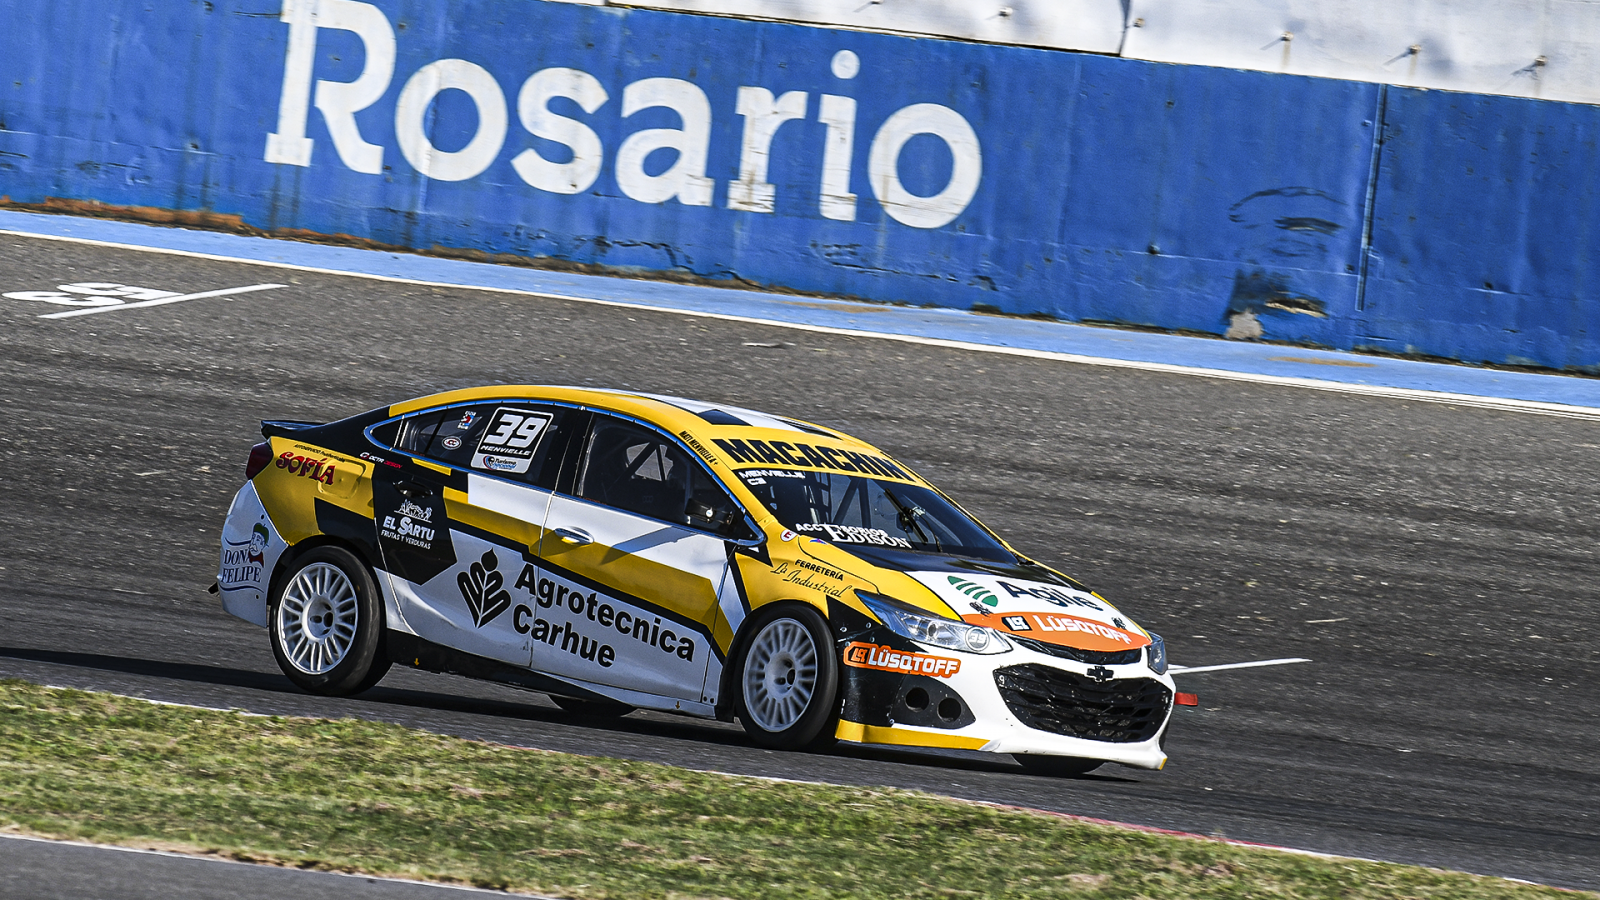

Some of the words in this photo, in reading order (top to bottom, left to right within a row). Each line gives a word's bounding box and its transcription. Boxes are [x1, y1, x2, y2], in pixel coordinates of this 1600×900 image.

[265, 0, 982, 229] Rosario
[484, 413, 547, 448] 39
[480, 445, 532, 456] MENVIELLE
[275, 452, 336, 485] SOFÍA
[738, 470, 805, 479] MENVIELLE
[381, 529, 400, 541] FRUTAS
[405, 536, 431, 550] VERDURAS
[383, 515, 397, 530] EL
[397, 516, 436, 540] SARTU
[224, 549, 249, 565] DON
[221, 566, 262, 583] FELIPE
[770, 562, 788, 574] La
[782, 569, 852, 598] Industrial
[795, 559, 844, 581] FERRETERÍA
[996, 580, 1104, 612] Agile
[513, 563, 696, 662] Agrotecnica
[513, 604, 616, 668] Carhue
[967, 632, 988, 644] 39
